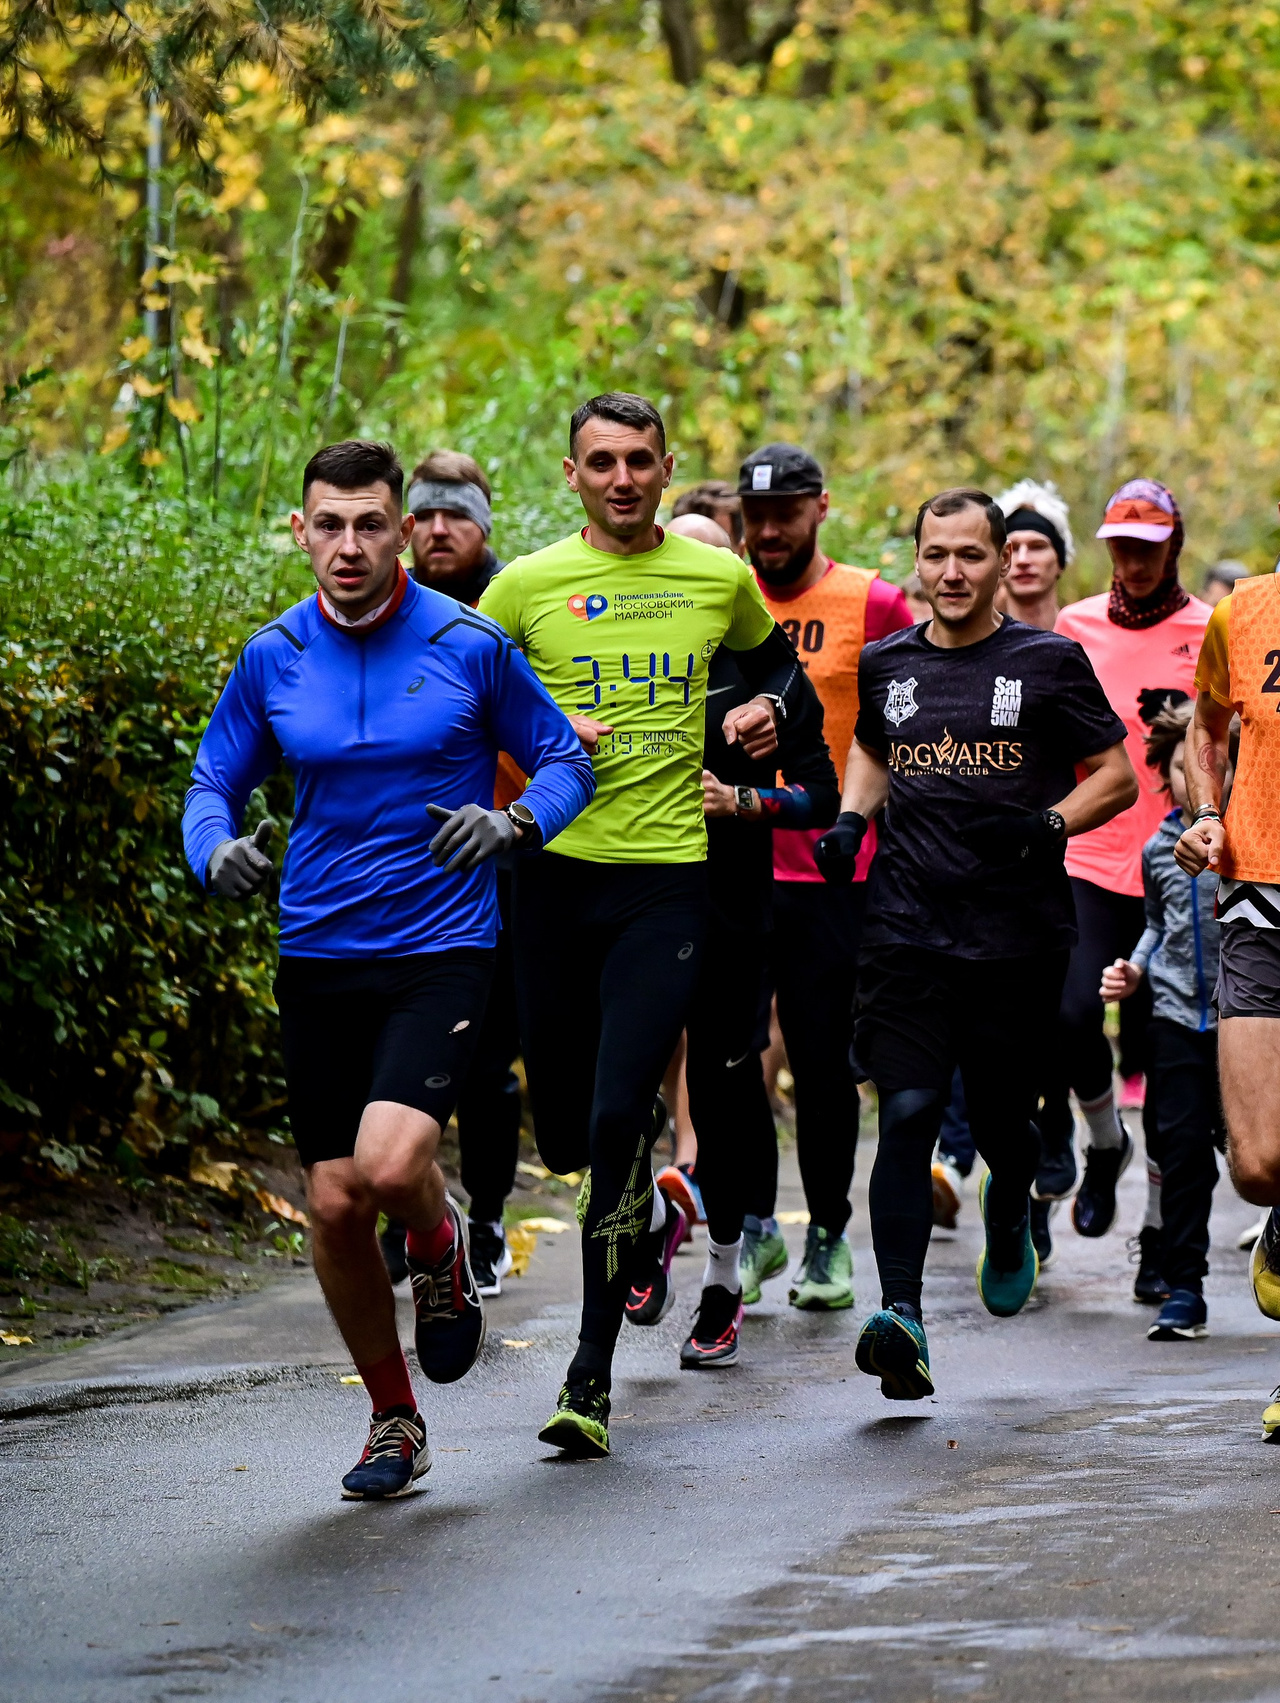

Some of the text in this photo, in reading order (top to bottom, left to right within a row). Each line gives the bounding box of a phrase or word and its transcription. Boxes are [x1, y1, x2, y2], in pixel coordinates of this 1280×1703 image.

[614, 590, 684, 602] Промсвязьбанк
[614, 599, 694, 611] МОСКОВСКИЙ
[615, 610, 673, 621] МАРАФОН
[571, 652, 695, 710] 3:44
[994, 676, 1022, 696] Sat
[992, 695, 1022, 711] 9AM
[990, 710, 1020, 727] 5KM
[642, 732, 688, 743] MINUTE
[642, 744, 661, 755] KM
[904, 767, 989, 777] RUNNING CLUB
